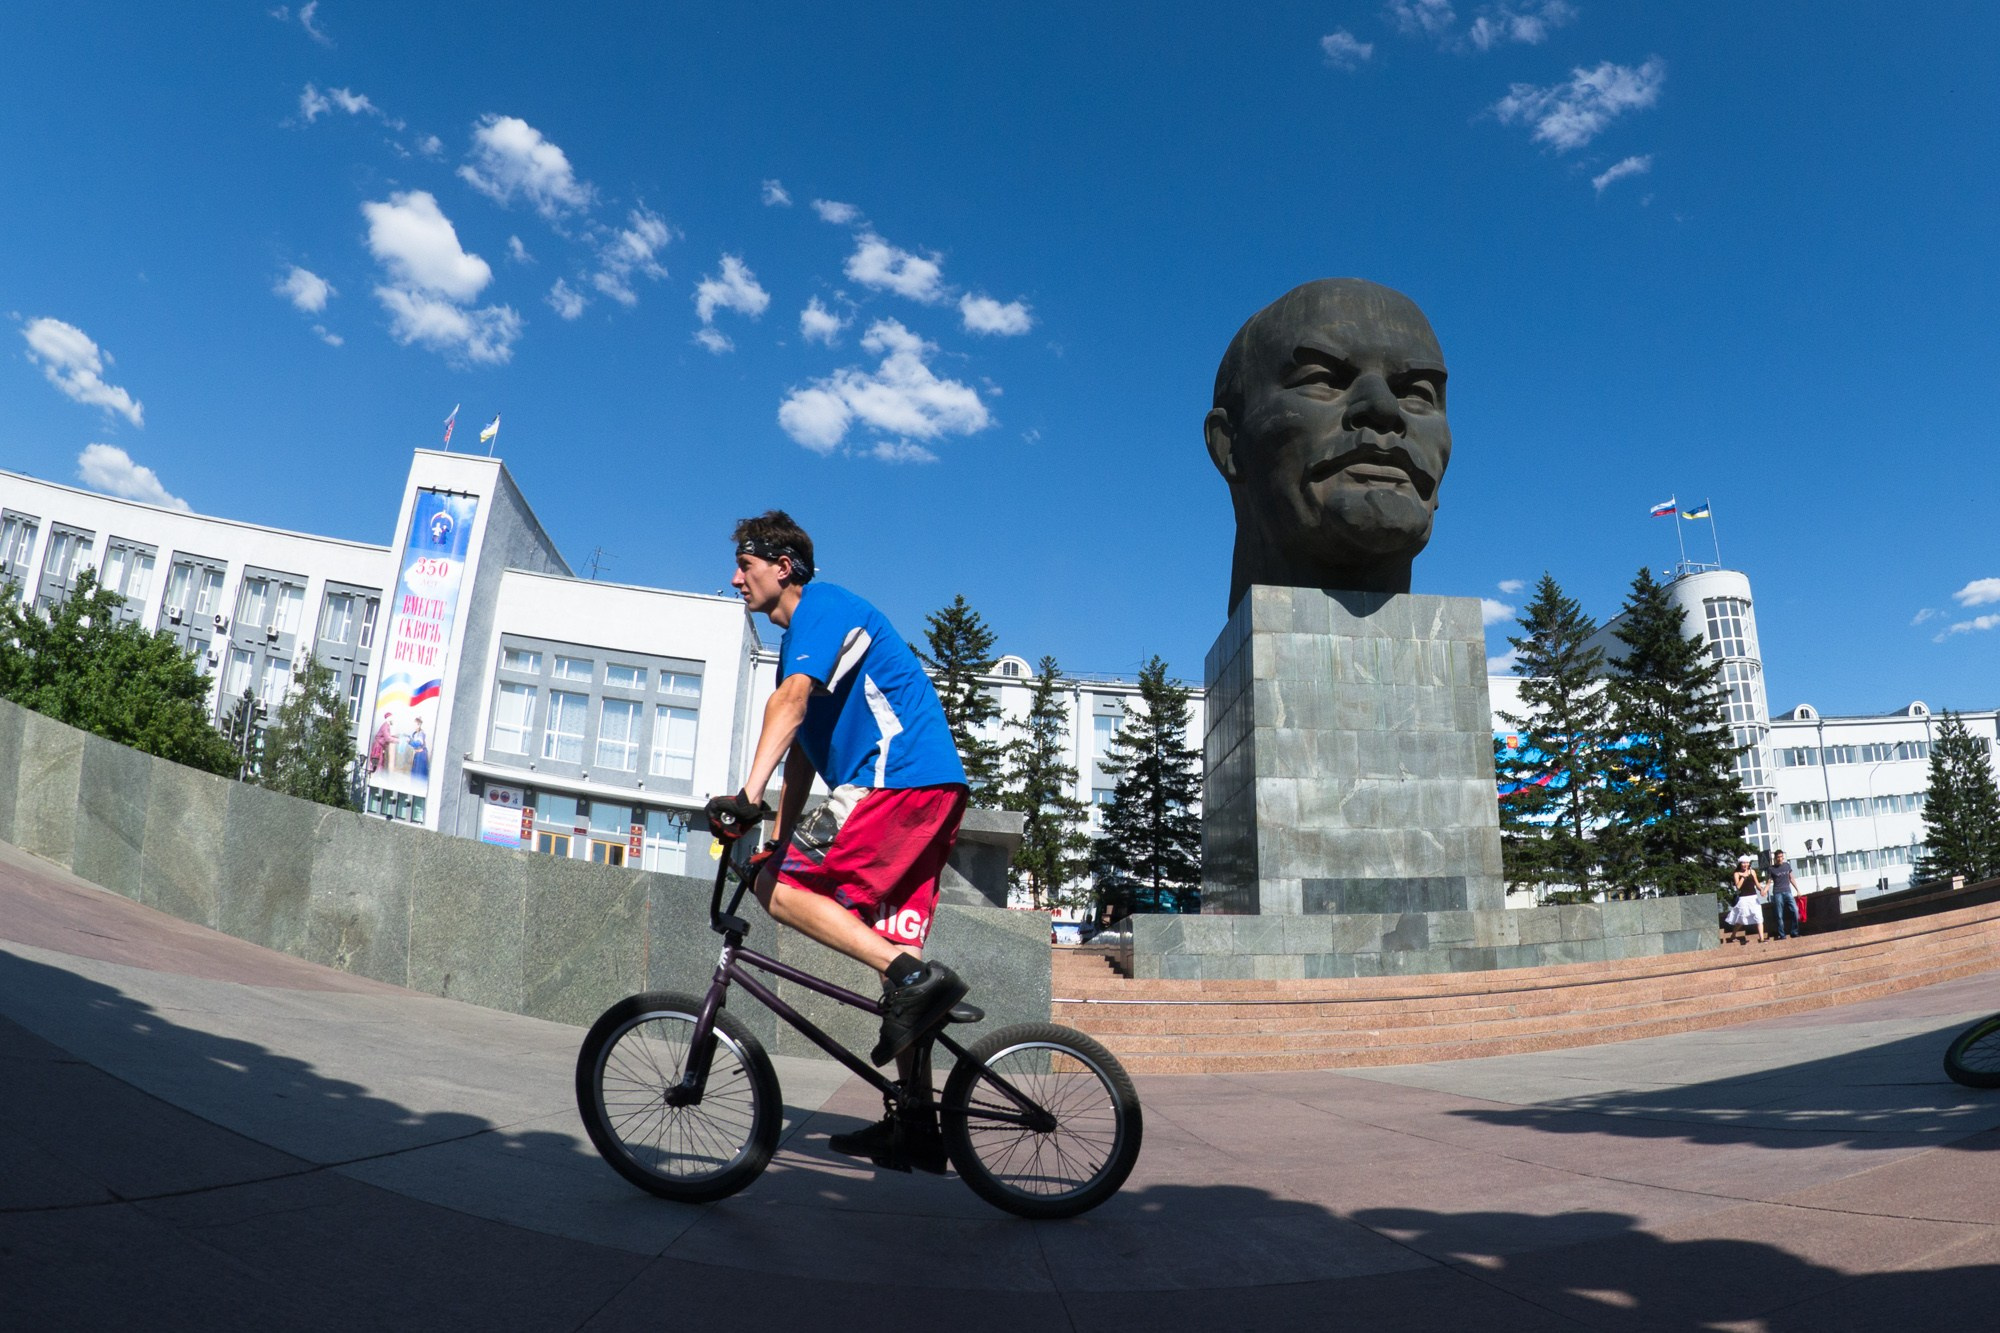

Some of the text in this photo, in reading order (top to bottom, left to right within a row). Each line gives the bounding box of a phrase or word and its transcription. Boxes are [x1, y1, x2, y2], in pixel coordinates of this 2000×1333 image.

[415, 557, 449, 577] 350
[402, 594, 448, 621] ВМЕСТЕ
[398, 617, 441, 643] СКВОЗЬ
[395, 641, 438, 667] ВРЕМЯ!
